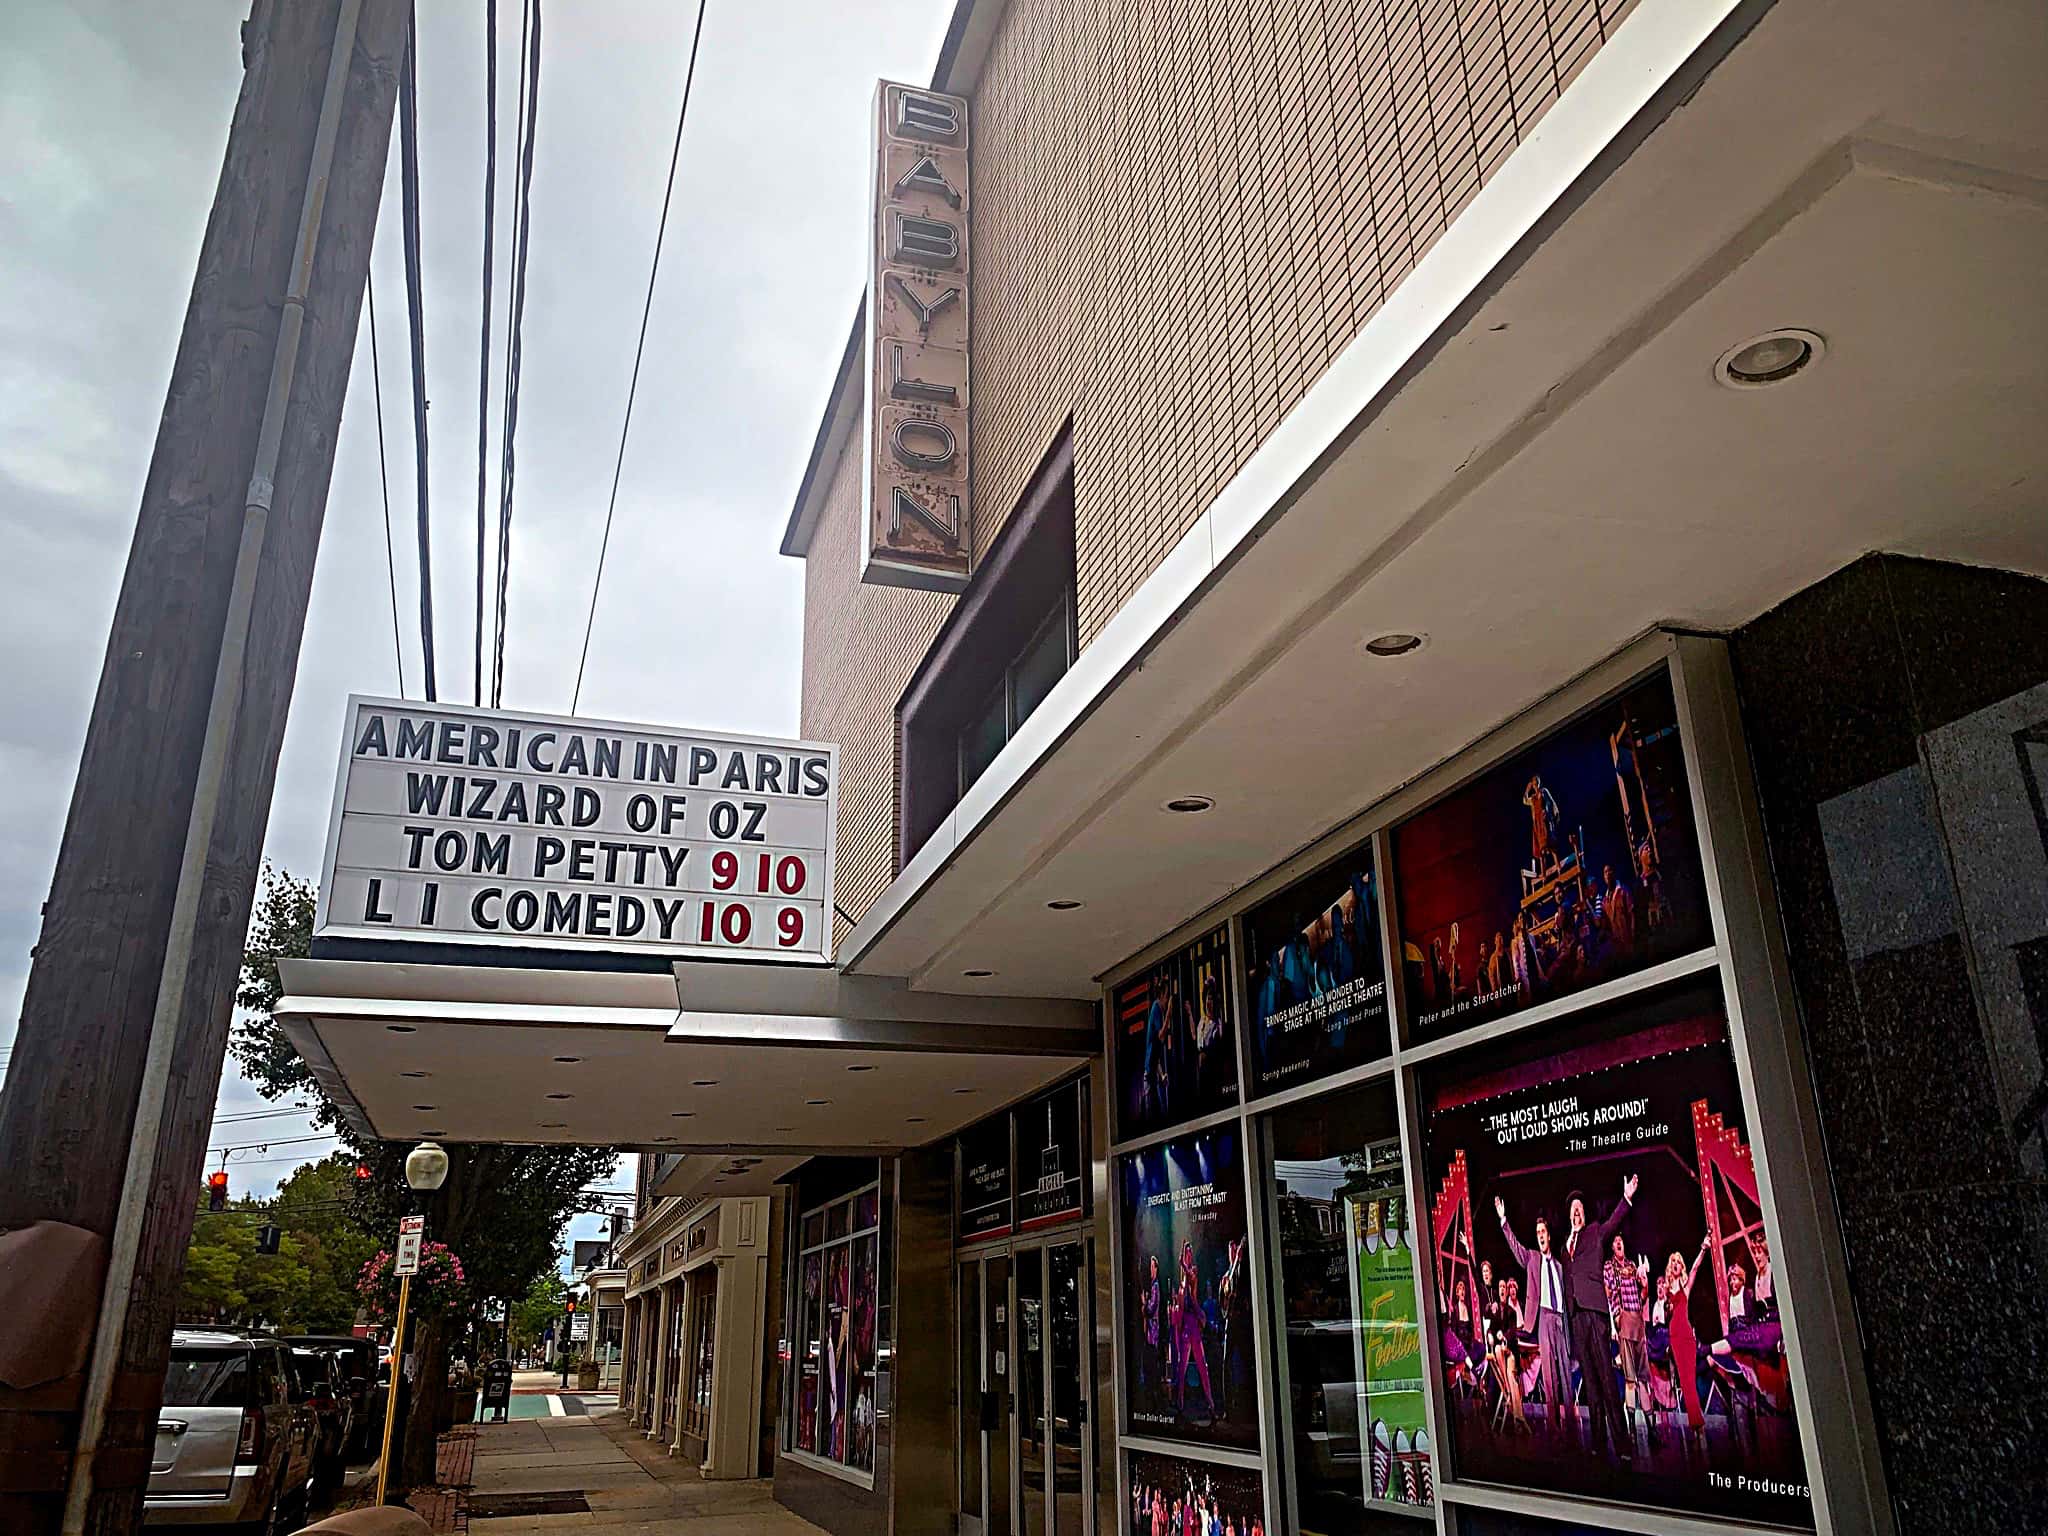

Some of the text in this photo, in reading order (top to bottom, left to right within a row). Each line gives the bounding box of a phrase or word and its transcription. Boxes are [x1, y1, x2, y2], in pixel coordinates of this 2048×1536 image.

[890, 90, 962, 549] BABYLON
[356, 716, 828, 797] AMERICAN IN PARIS
[407, 772, 768, 842] WIZARD OF OZ
[404, 826, 806, 894] TOM PETTY 9 10
[364, 879, 392, 923] L
[471, 888, 686, 940] COMEDY
[701, 901, 752, 943] 10
[777, 907, 804, 947] 9
[1283, 1018, 1304, 1033] STAGE
[1304, 1012, 1313, 1025] AT
[1313, 1005, 1328, 1020] THE
[1328, 996, 1352, 1016] ARGYLE
[1288, 1000, 1309, 1018] MAGIC
[1310, 995, 1325, 1010] AND
[1325, 981, 1354, 1003] WONDER
[1354, 977, 1365, 990] TO
[1419, 982, 1522, 1027] Peter and the Starcatcher
[1497, 1128, 1518, 1145] OUT
[1520, 1120, 1548, 1141] LOUD
[1551, 1111, 1590, 1134] SHOWS
[1510, 1105, 1539, 1127] MOST
[1541, 1096, 1579, 1119] LAUGH
[1591, 1131, 1631, 1148] Theatre
[1636, 1122, 1669, 1140] Guide
[1708, 1471, 1811, 1498] The Producers
